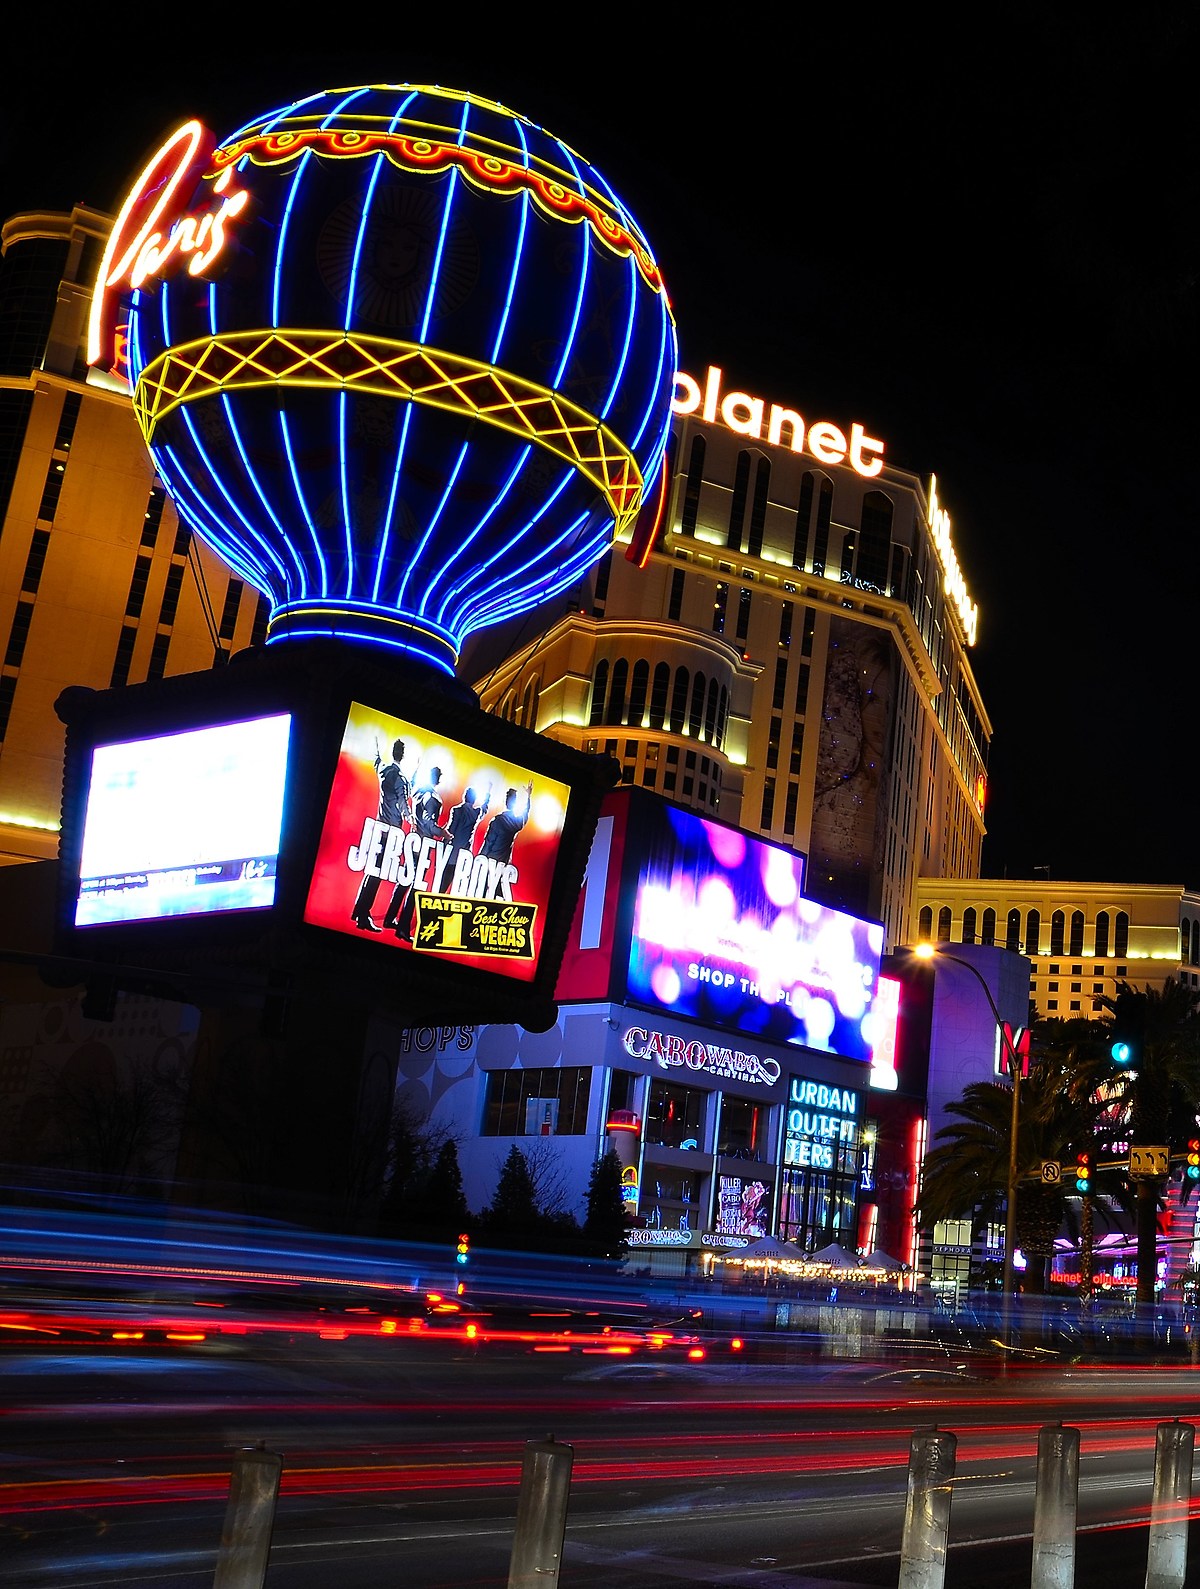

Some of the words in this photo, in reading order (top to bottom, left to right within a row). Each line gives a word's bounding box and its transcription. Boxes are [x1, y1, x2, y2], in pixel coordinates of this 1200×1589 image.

[88, 119, 248, 366] Paris
[347, 816, 454, 894] JERSEY
[451, 848, 519, 902] BOYS
[420, 896, 473, 913] RATED
[472, 905, 498, 925] Best
[499, 906, 529, 927] Show
[420, 912, 468, 949] #1
[479, 924, 526, 948] VEGAS
[687, 962, 735, 990] SHOP
[709, 1065, 757, 1084] CANTINA
[791, 1079, 856, 1115] URBAN
[789, 1109, 857, 1142] OUTFIT
[784, 1138, 833, 1169] TERS
[722, 1177, 741, 1190] KILLER
[722, 1194, 741, 1204] CABO
[722, 1217, 736, 1228] FOOD
[934, 1246, 972, 1254] SEPHORA
[1093, 1272, 1138, 1287] ollywoo
